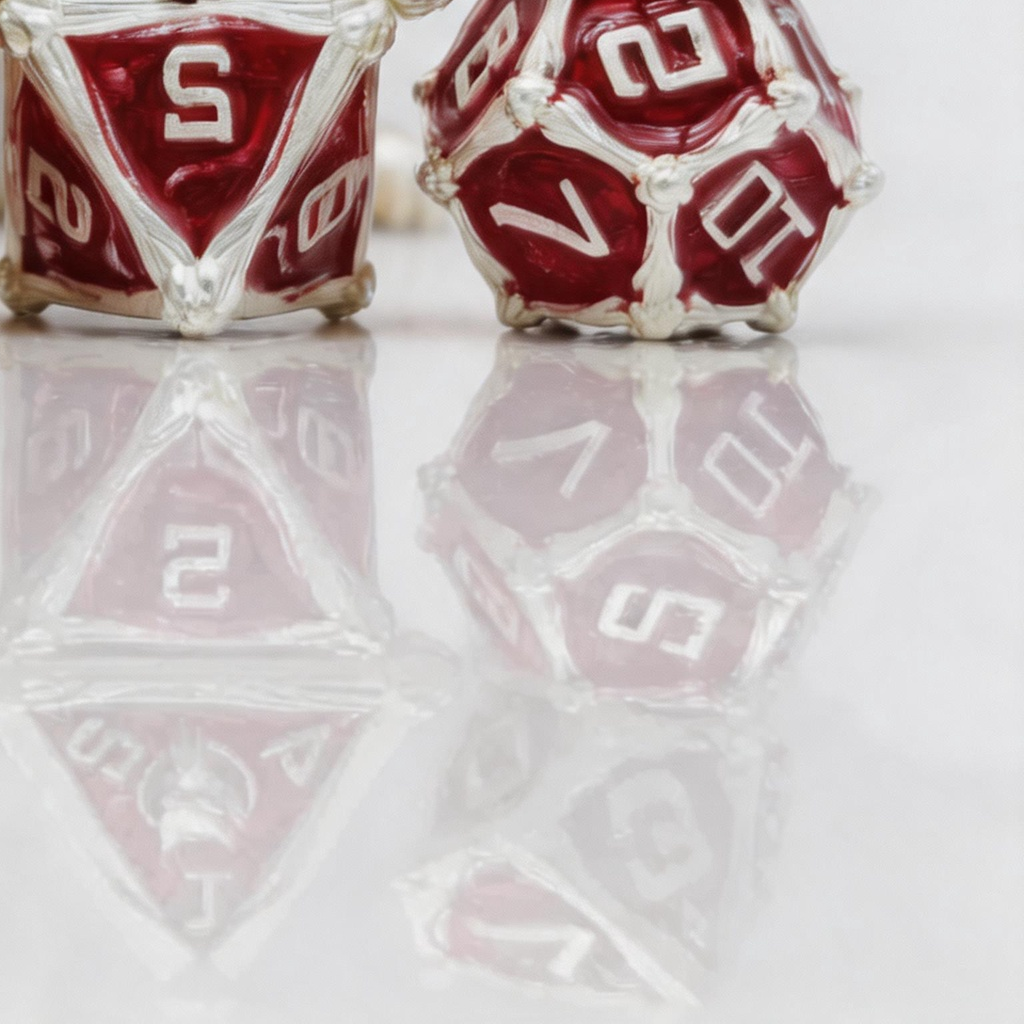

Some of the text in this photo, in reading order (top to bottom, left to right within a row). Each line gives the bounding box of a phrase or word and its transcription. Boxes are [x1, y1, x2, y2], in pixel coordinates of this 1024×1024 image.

[596, 6, 729, 99] 2
[488, 177, 611, 259] 7
[700, 159, 816, 288] 10
